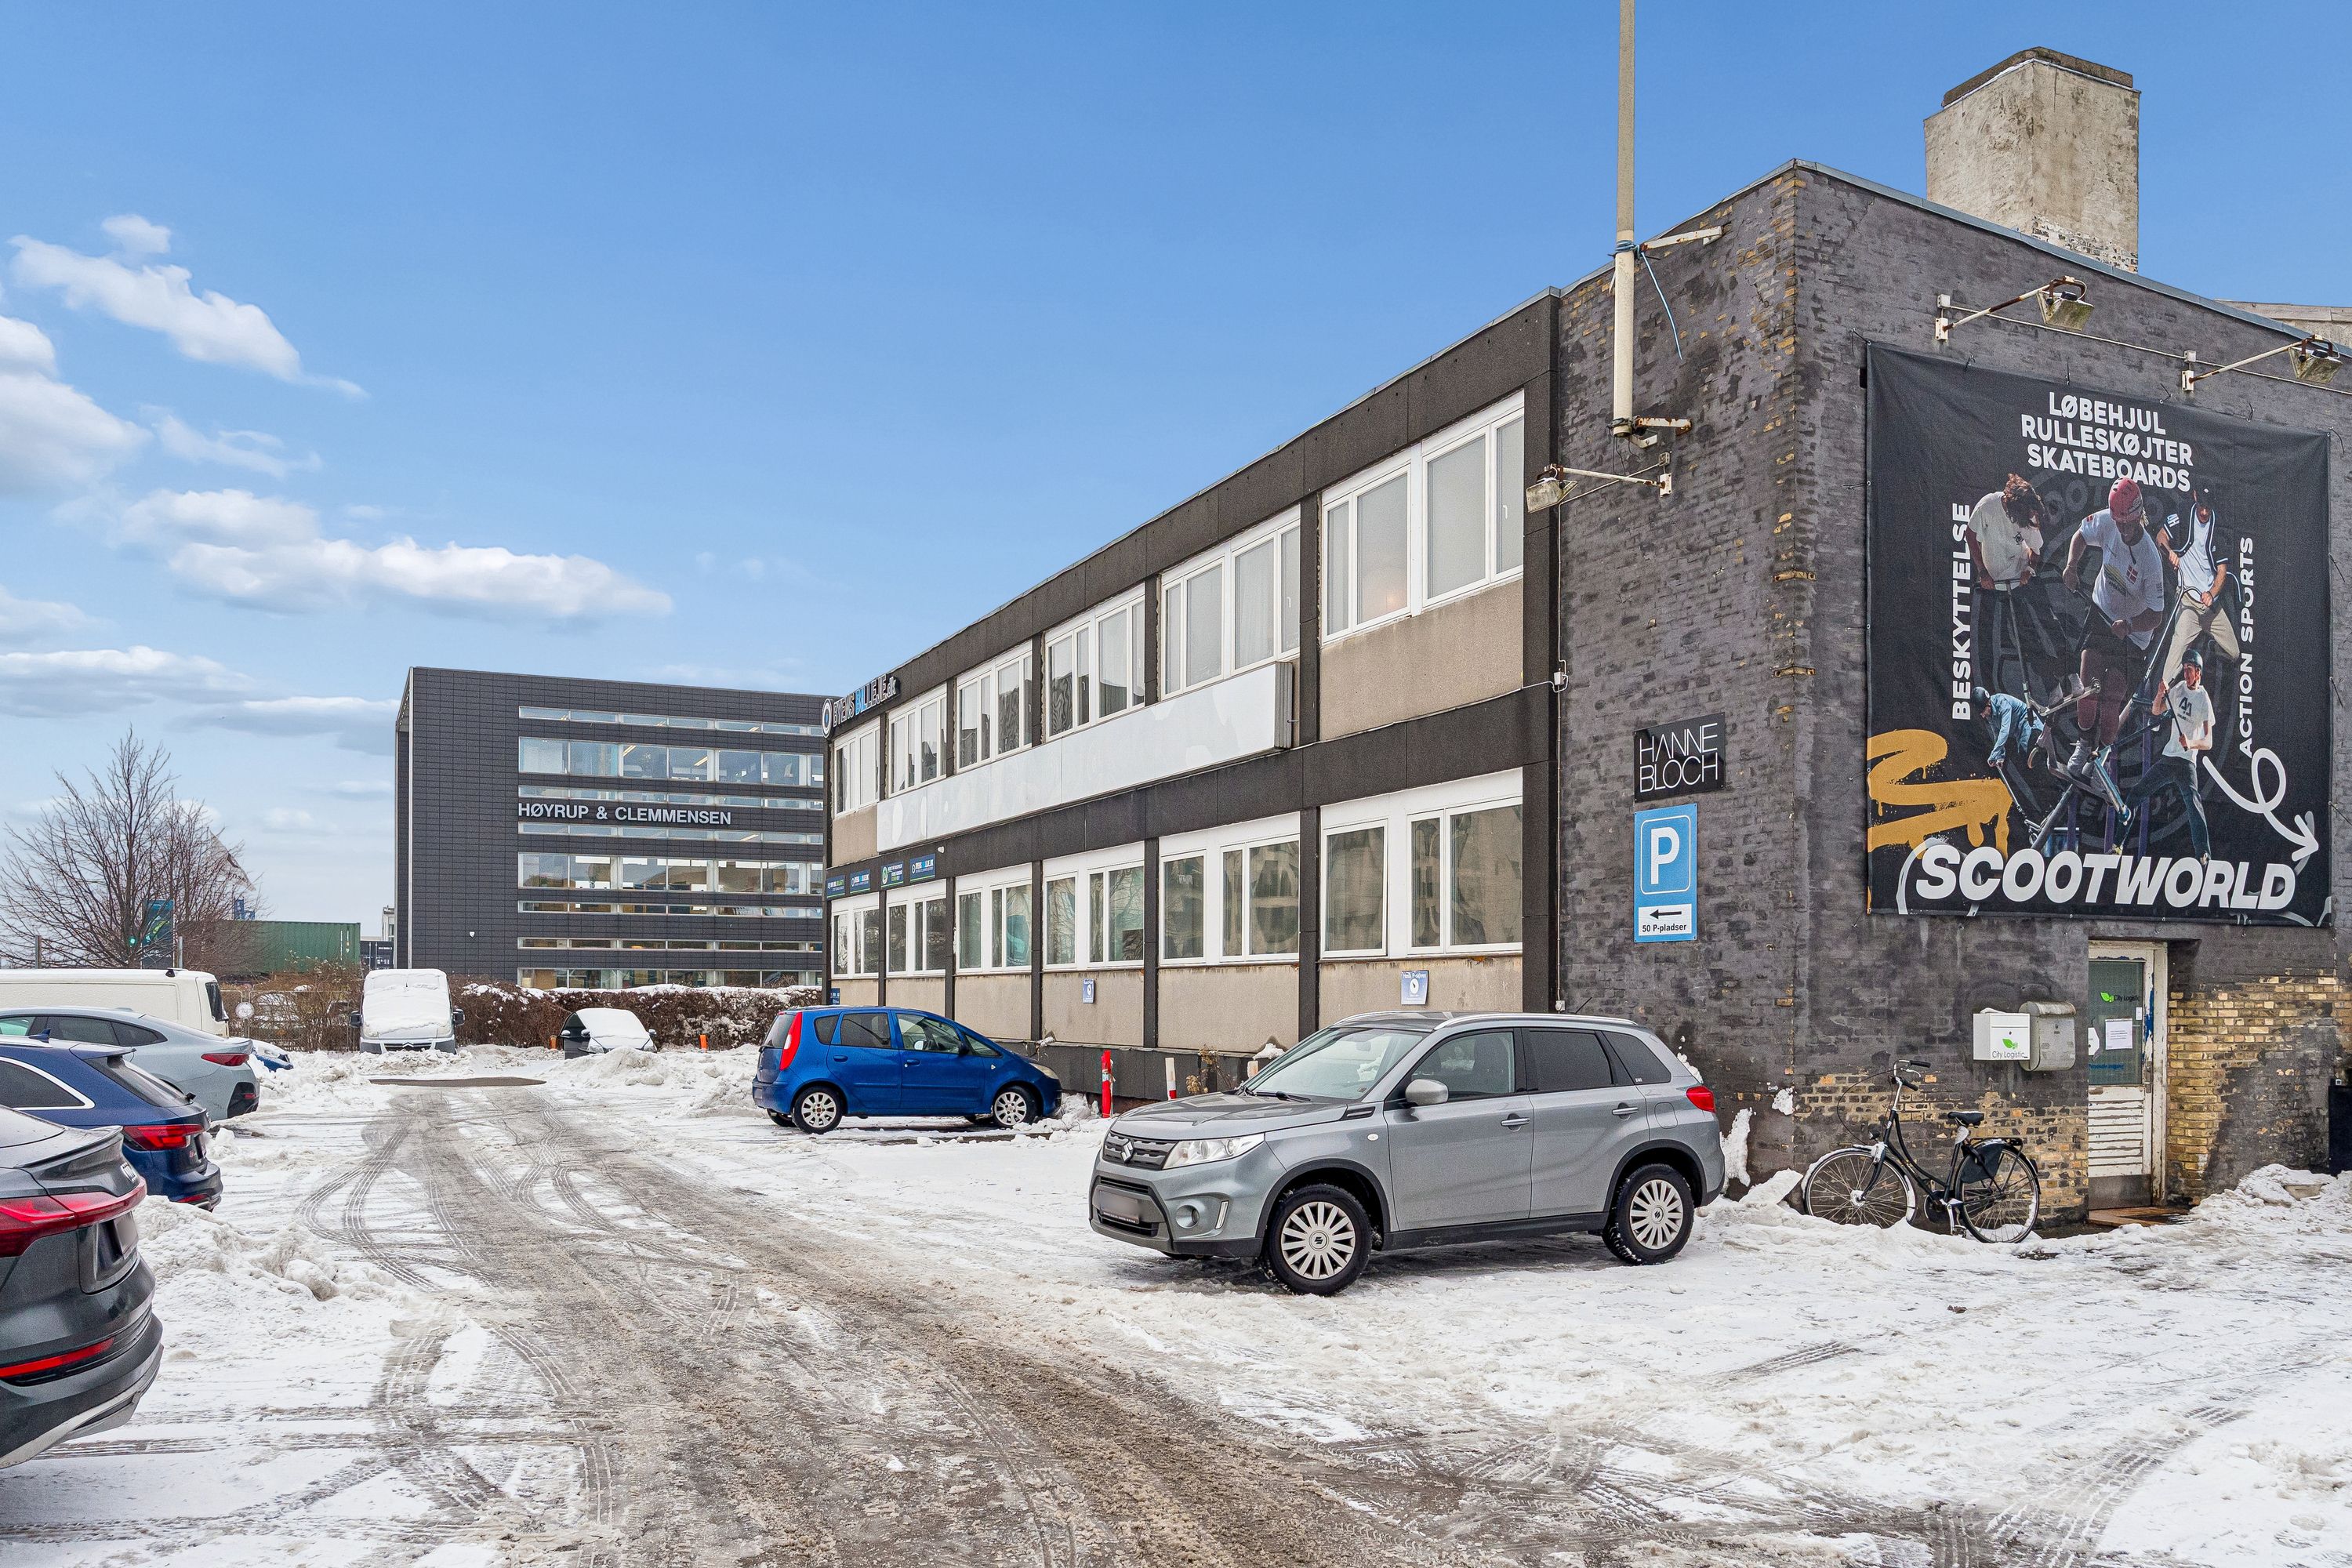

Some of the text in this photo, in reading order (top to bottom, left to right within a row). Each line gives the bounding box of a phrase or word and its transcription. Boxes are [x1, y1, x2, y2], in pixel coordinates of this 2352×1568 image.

[2049, 391, 2166, 435] LØBEHJUL
[2021, 413, 2193, 466] RULLESKØJTER
[2027, 443, 2191, 493] SKATEBOARDS
[1951, 503, 1972, 720] BESKYTTELSE
[2239, 536, 2254, 758] ACTION SPORTS
[1639, 722, 1718, 764] HANNE
[1639, 752, 1719, 793] BLOCH
[517, 802, 731, 826] HØYRUP & CLEMMENSEN
[1650, 826, 1680, 885] P
[1916, 843, 2296, 911] SCOOTWORLD
[1642, 923, 1687, 934] 50 P-pladser
[1991, 1051, 2003, 1059] City
